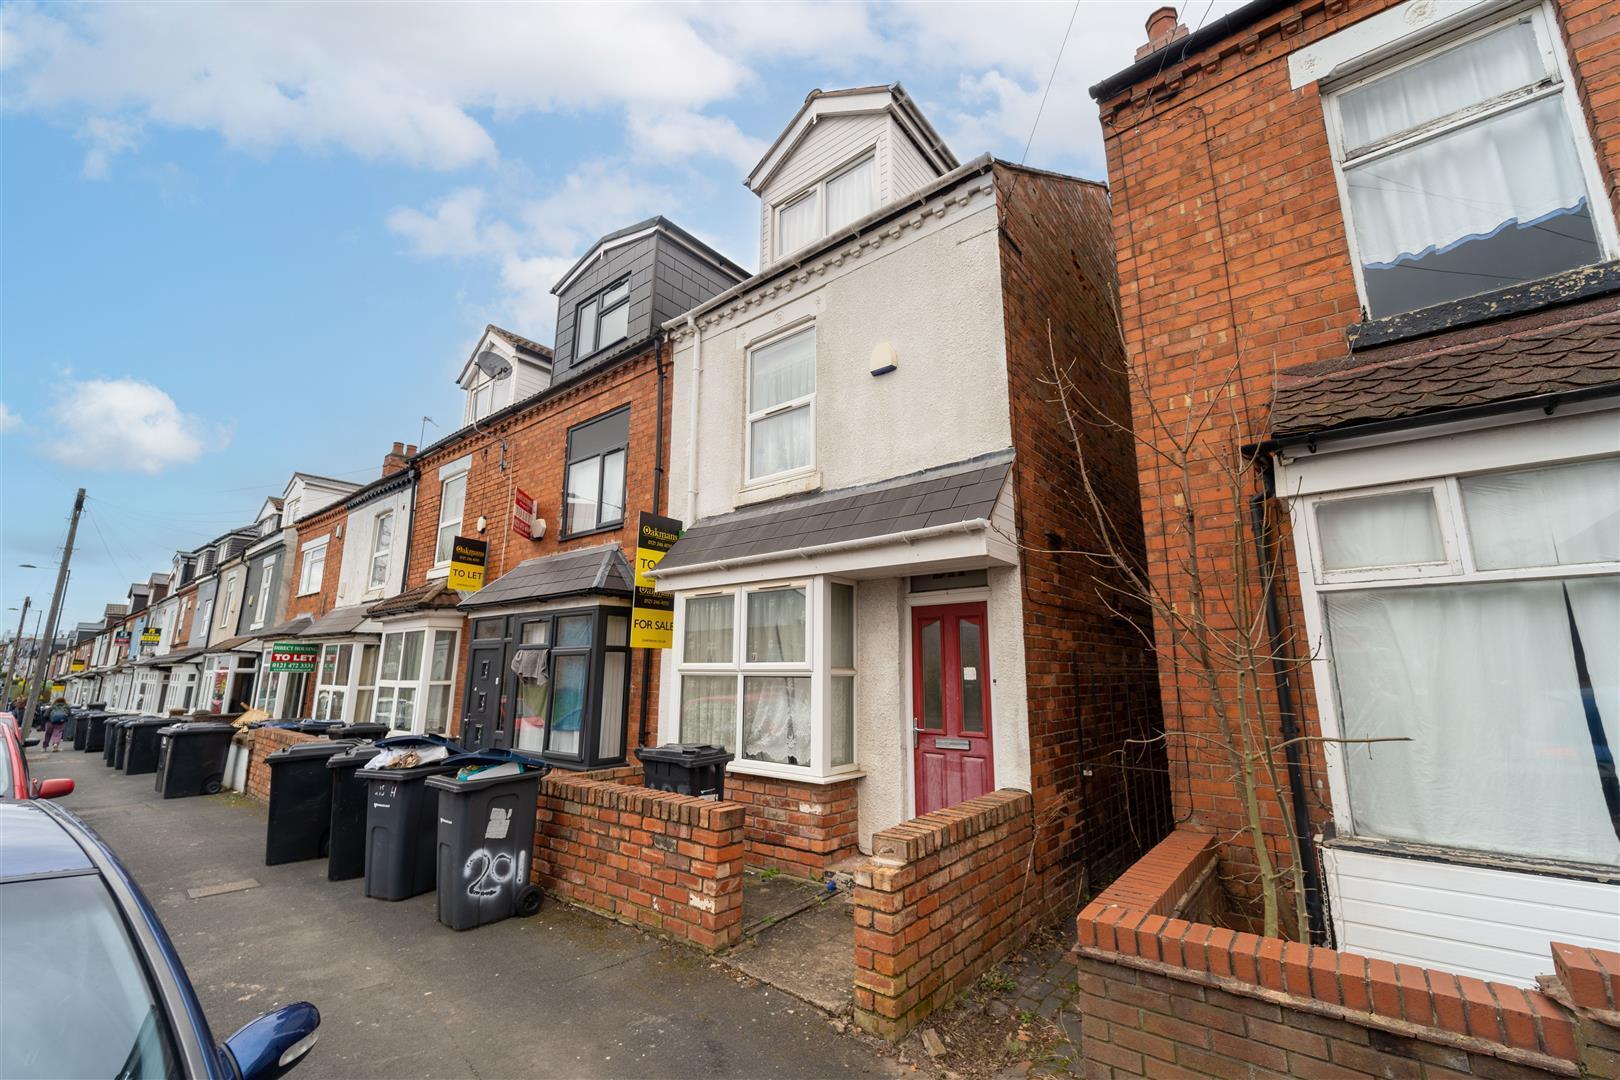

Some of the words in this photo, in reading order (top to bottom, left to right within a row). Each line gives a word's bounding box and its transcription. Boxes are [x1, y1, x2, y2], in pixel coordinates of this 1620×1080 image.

[641, 558, 656, 569] TO
[453, 568, 465, 578] TO
[467, 571, 482, 580] LET
[634, 618, 653, 629] FOR
[655, 620, 674, 631] SALE
[274, 653, 290, 661] TO
[293, 654, 315, 662] LET
[463, 848, 526, 897] 201
